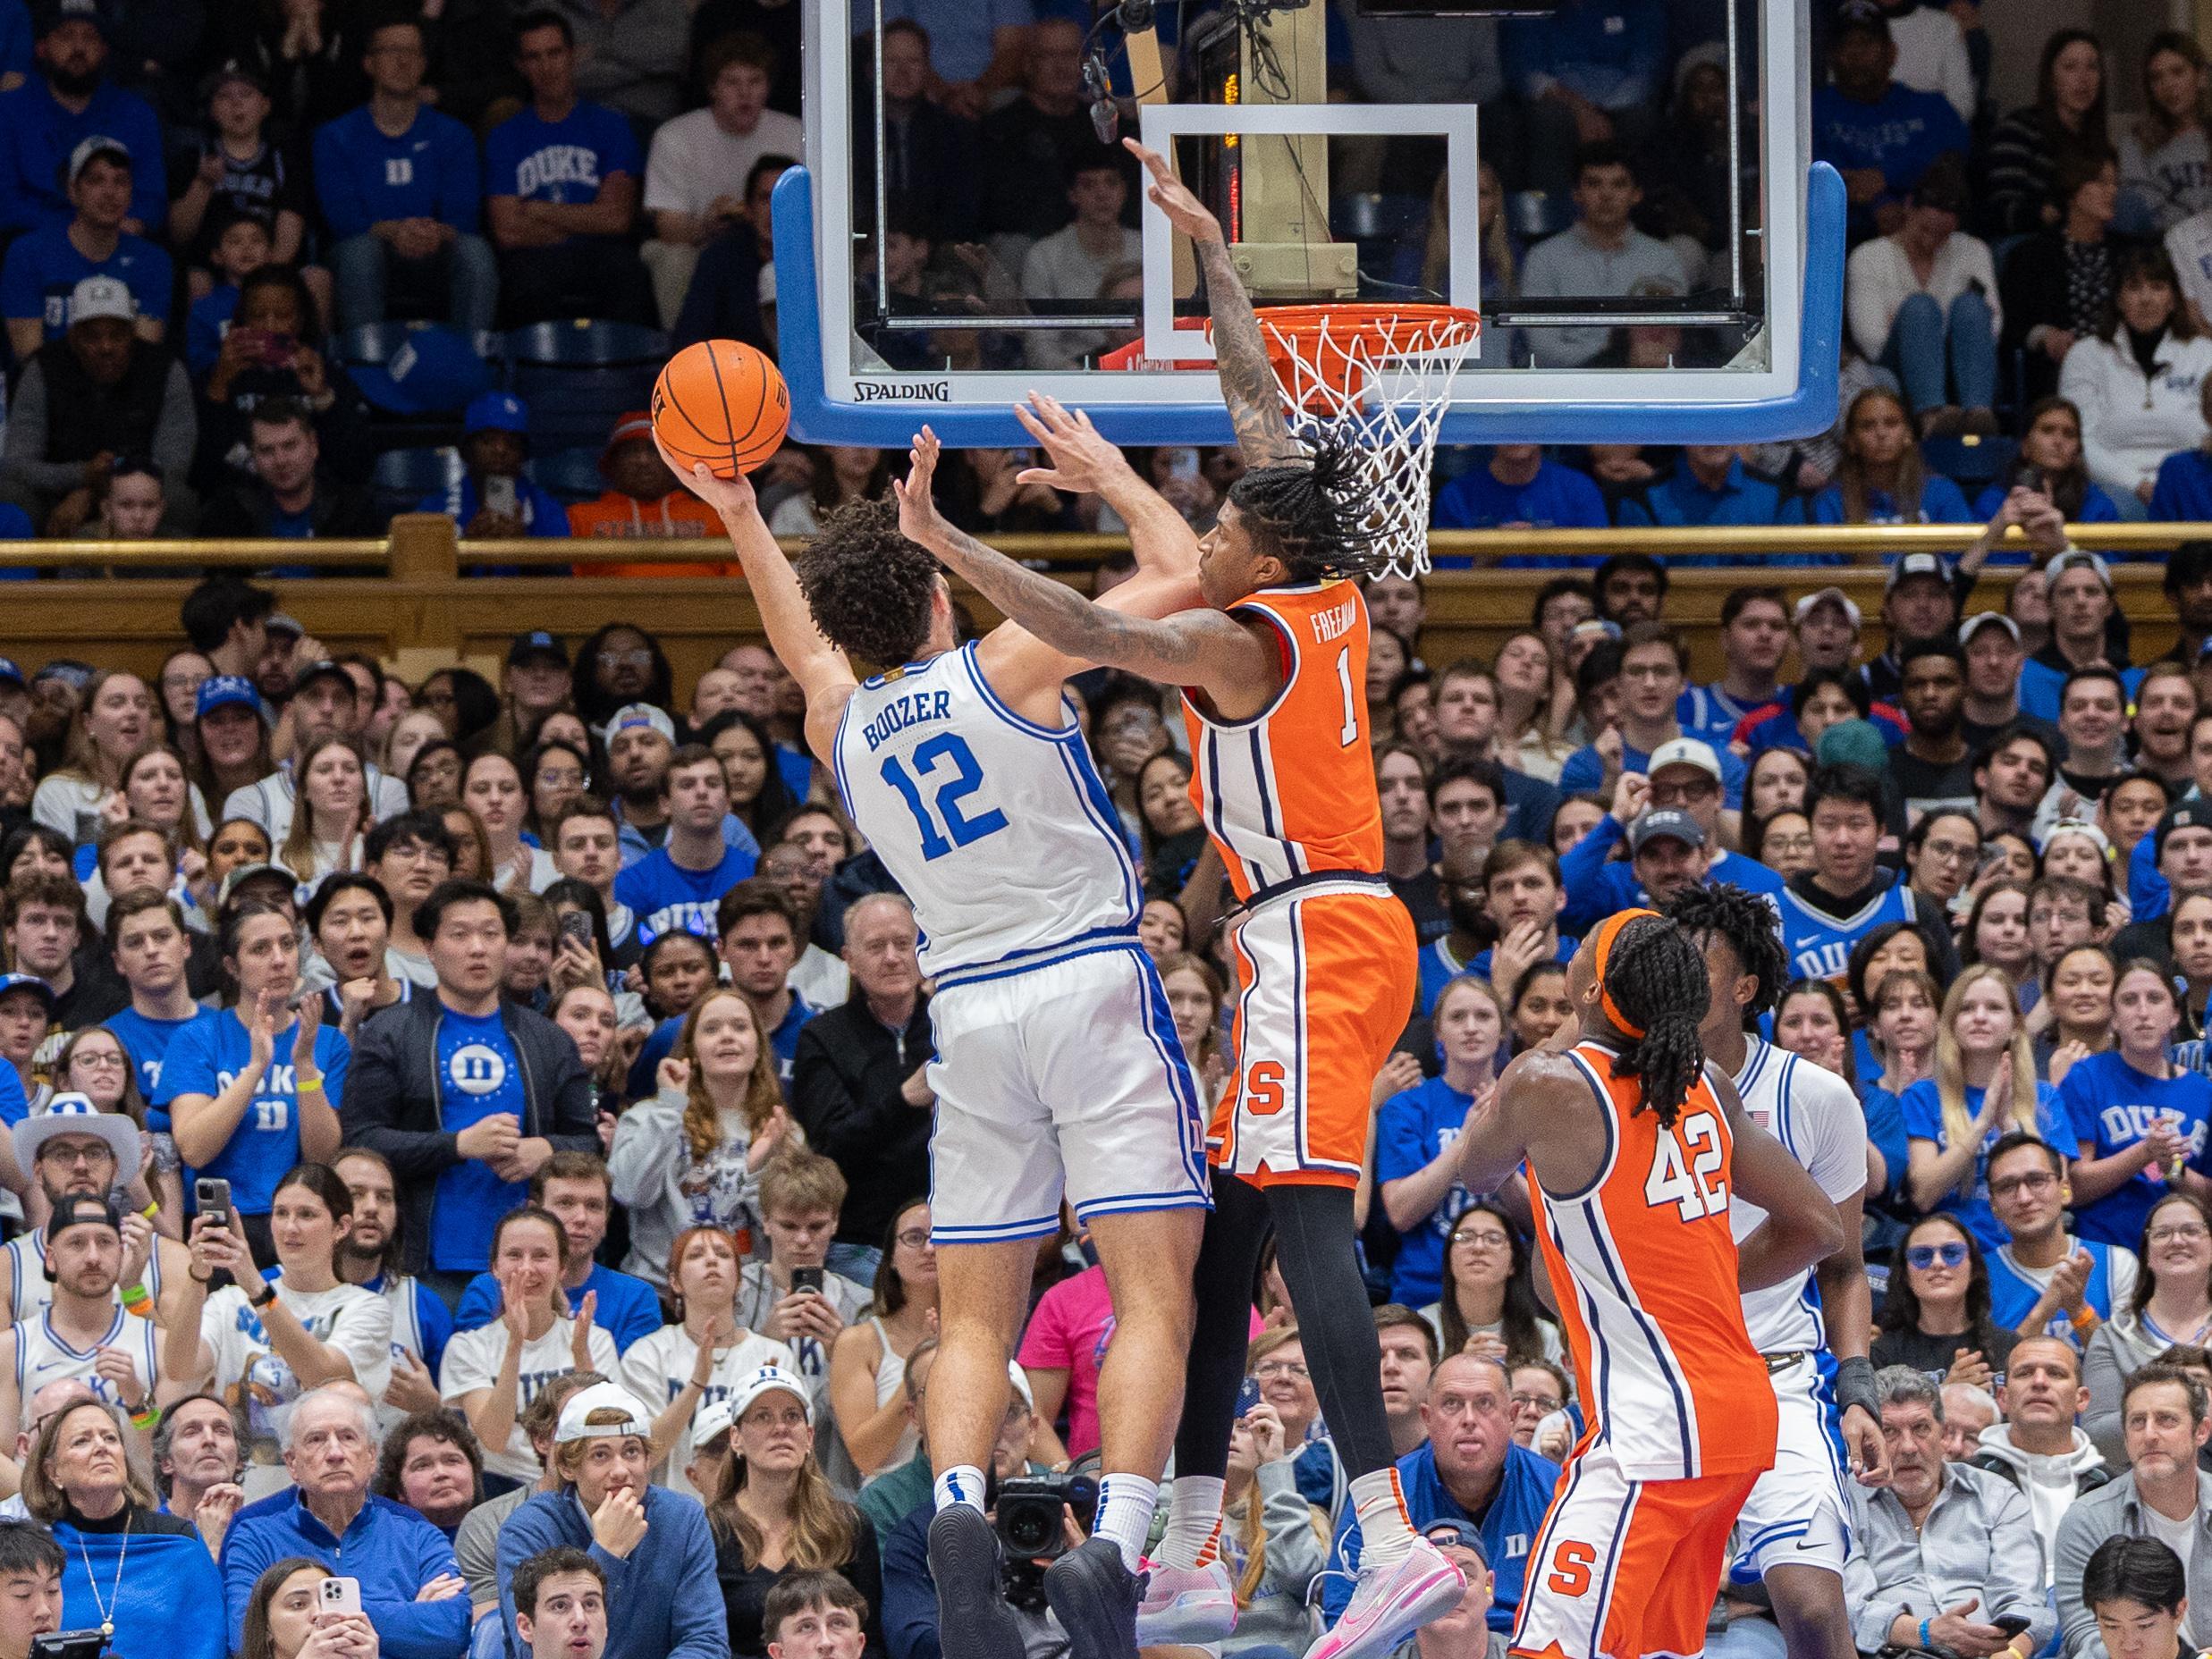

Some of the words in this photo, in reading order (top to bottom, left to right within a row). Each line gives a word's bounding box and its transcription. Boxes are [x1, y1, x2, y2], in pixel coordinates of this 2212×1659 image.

[517, 145, 599, 196] DUKE
[855, 382, 947, 401] SPALDING
[862, 690, 951, 752] BOOZER
[1337, 644, 1359, 748] 1
[880, 731, 1009, 862] 12
[1247, 1060, 1285, 1116] S
[1643, 1110, 1727, 1224] 42
[1548, 1539, 1597, 1598] S
